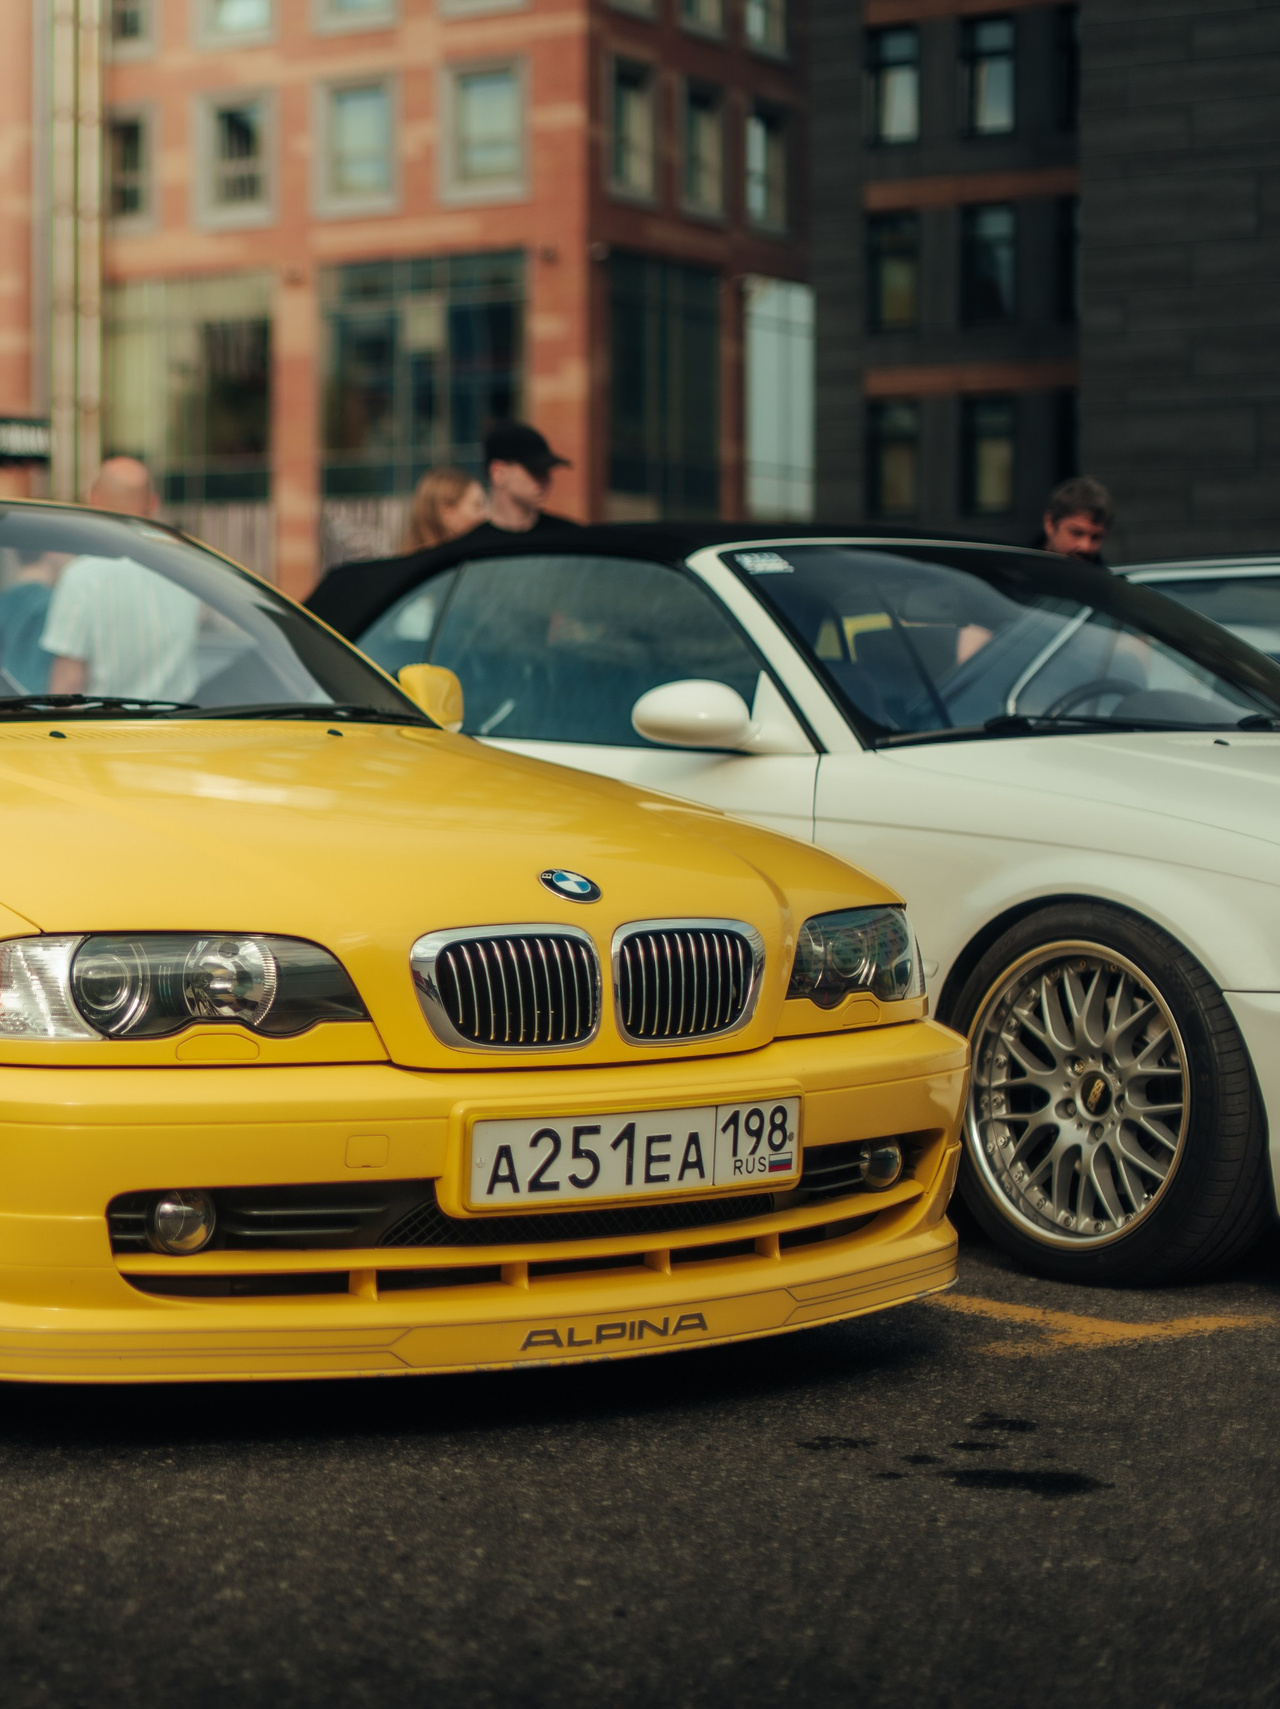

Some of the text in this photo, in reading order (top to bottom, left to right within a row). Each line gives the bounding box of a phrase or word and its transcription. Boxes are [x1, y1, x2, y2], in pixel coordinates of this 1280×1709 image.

[486, 1104, 788, 1195] A251EA 198
[733, 1156, 767, 1176] RUS
[519, 1312, 709, 1351] ALPINA
